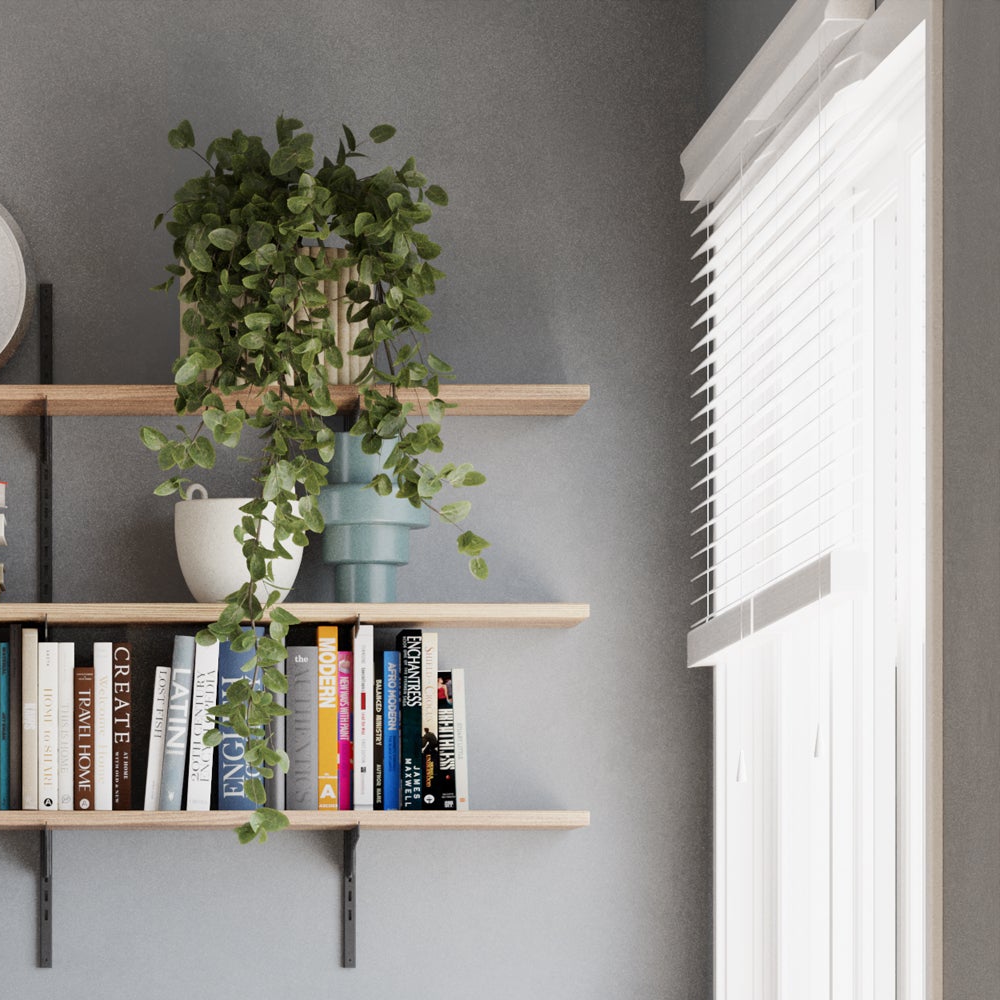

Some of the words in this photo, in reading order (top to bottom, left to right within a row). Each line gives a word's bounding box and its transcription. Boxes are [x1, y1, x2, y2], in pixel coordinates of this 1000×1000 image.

[294, 654, 309, 663] the
[319, 637, 337, 708] MODERN
[387, 662, 397, 689] AFRO
[407, 636, 422, 707] ENCHANTRESS
[425, 646, 435, 678] SHIELD
[114, 647, 130, 744] CREATE
[157, 671, 167, 703] LOST
[340, 676, 349, 692] NEW
[340, 692, 349, 707] WAYS
[44, 688, 53, 723] HOME
[60, 705, 69, 727] THIS
[79, 688, 91, 741] TRAVEL
[98, 675, 109, 736] Welcome
[194, 670, 206, 736] CENTURY
[340, 707, 349, 723] WITH
[387, 690, 397, 731] MODERN
[425, 686, 435, 723] CROCUS
[60, 729, 69, 738] IS
[154, 709, 164, 739] FISH
[340, 723, 349, 741] PAINT
[438, 708, 455, 770] BREATHLESS
[44, 745, 53, 786] SHARE
[60, 743, 69, 774] HOME
[79, 745, 91, 791] HOME
[98, 744, 109, 784] Home
[123, 752, 129, 760] AT
[413, 765, 421, 800] JAMES
